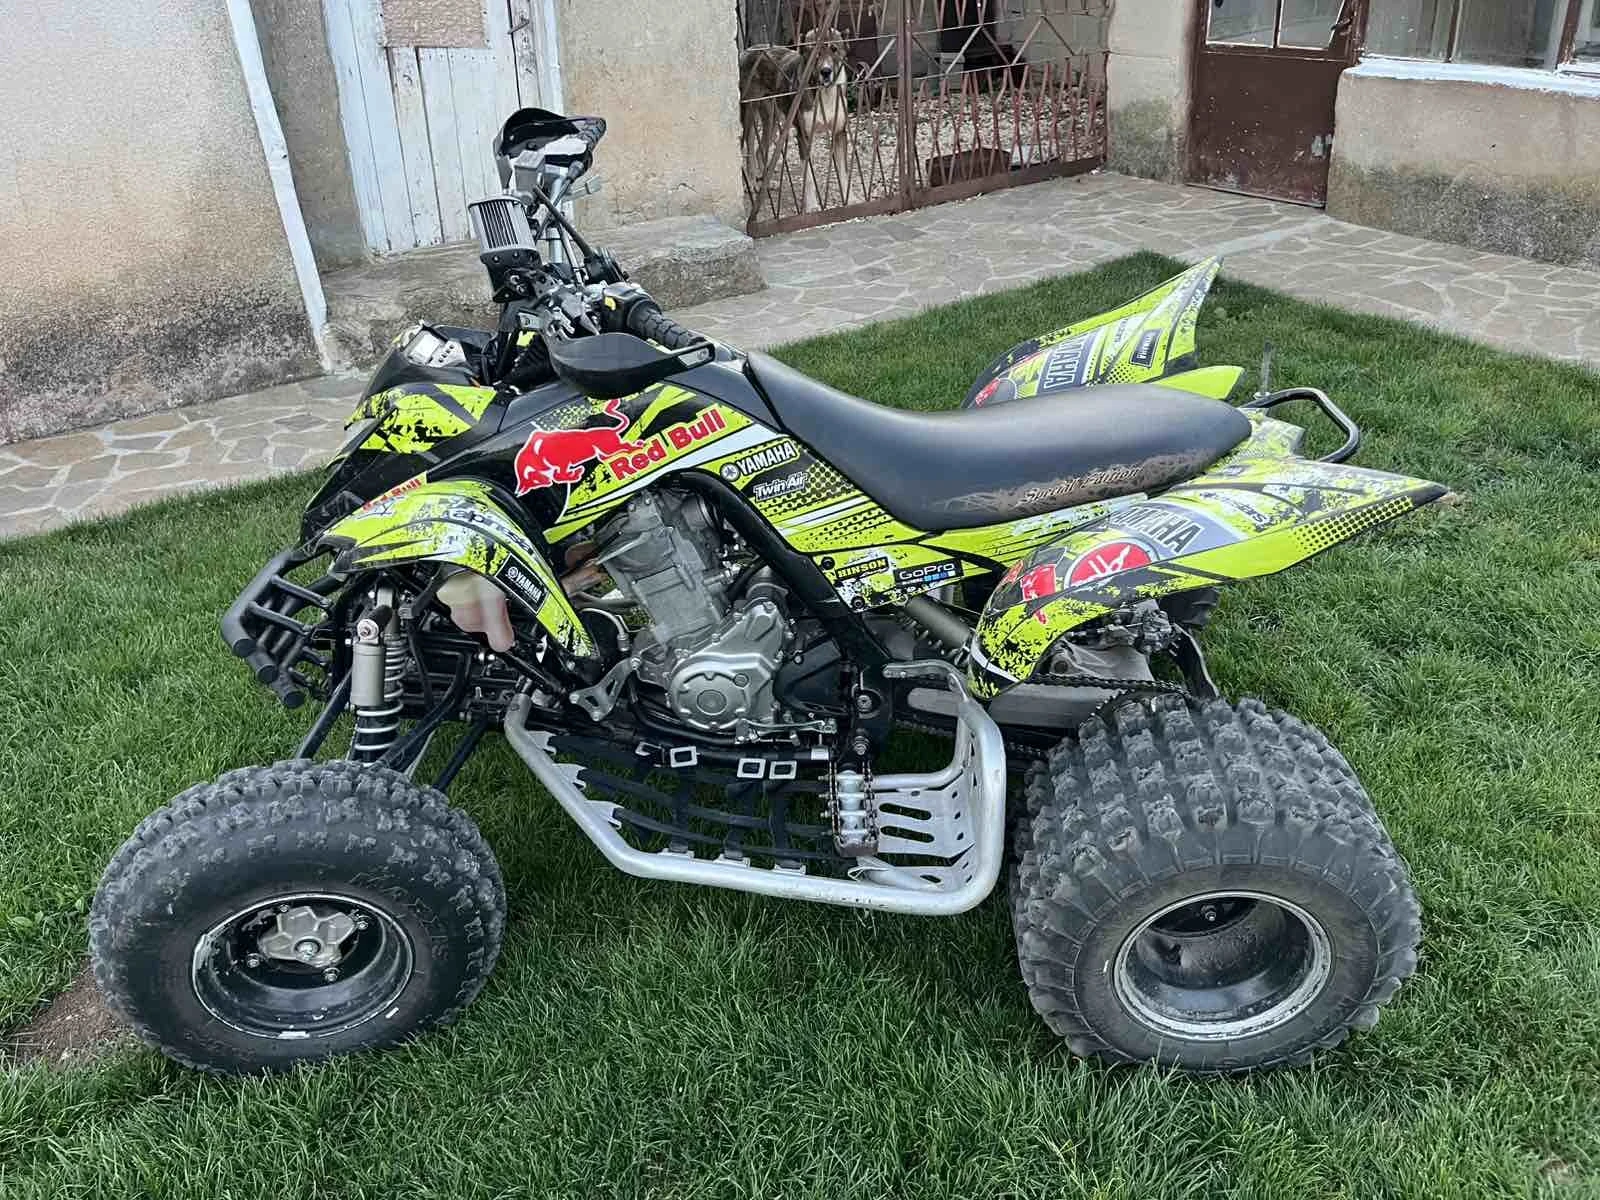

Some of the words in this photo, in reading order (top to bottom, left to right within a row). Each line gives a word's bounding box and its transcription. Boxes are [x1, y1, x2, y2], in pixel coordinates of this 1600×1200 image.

[1043, 333, 1086, 389] MAHA
[609, 438, 667, 481] Red
[667, 408, 726, 450] Bull
[736, 442, 795, 475] YAMAHA
[1109, 505, 1205, 555] AMAHA
[837, 559, 887, 579] HINSON
[899, 562, 956, 580] GoPro
[515, 571, 543, 602] YAMAHA
